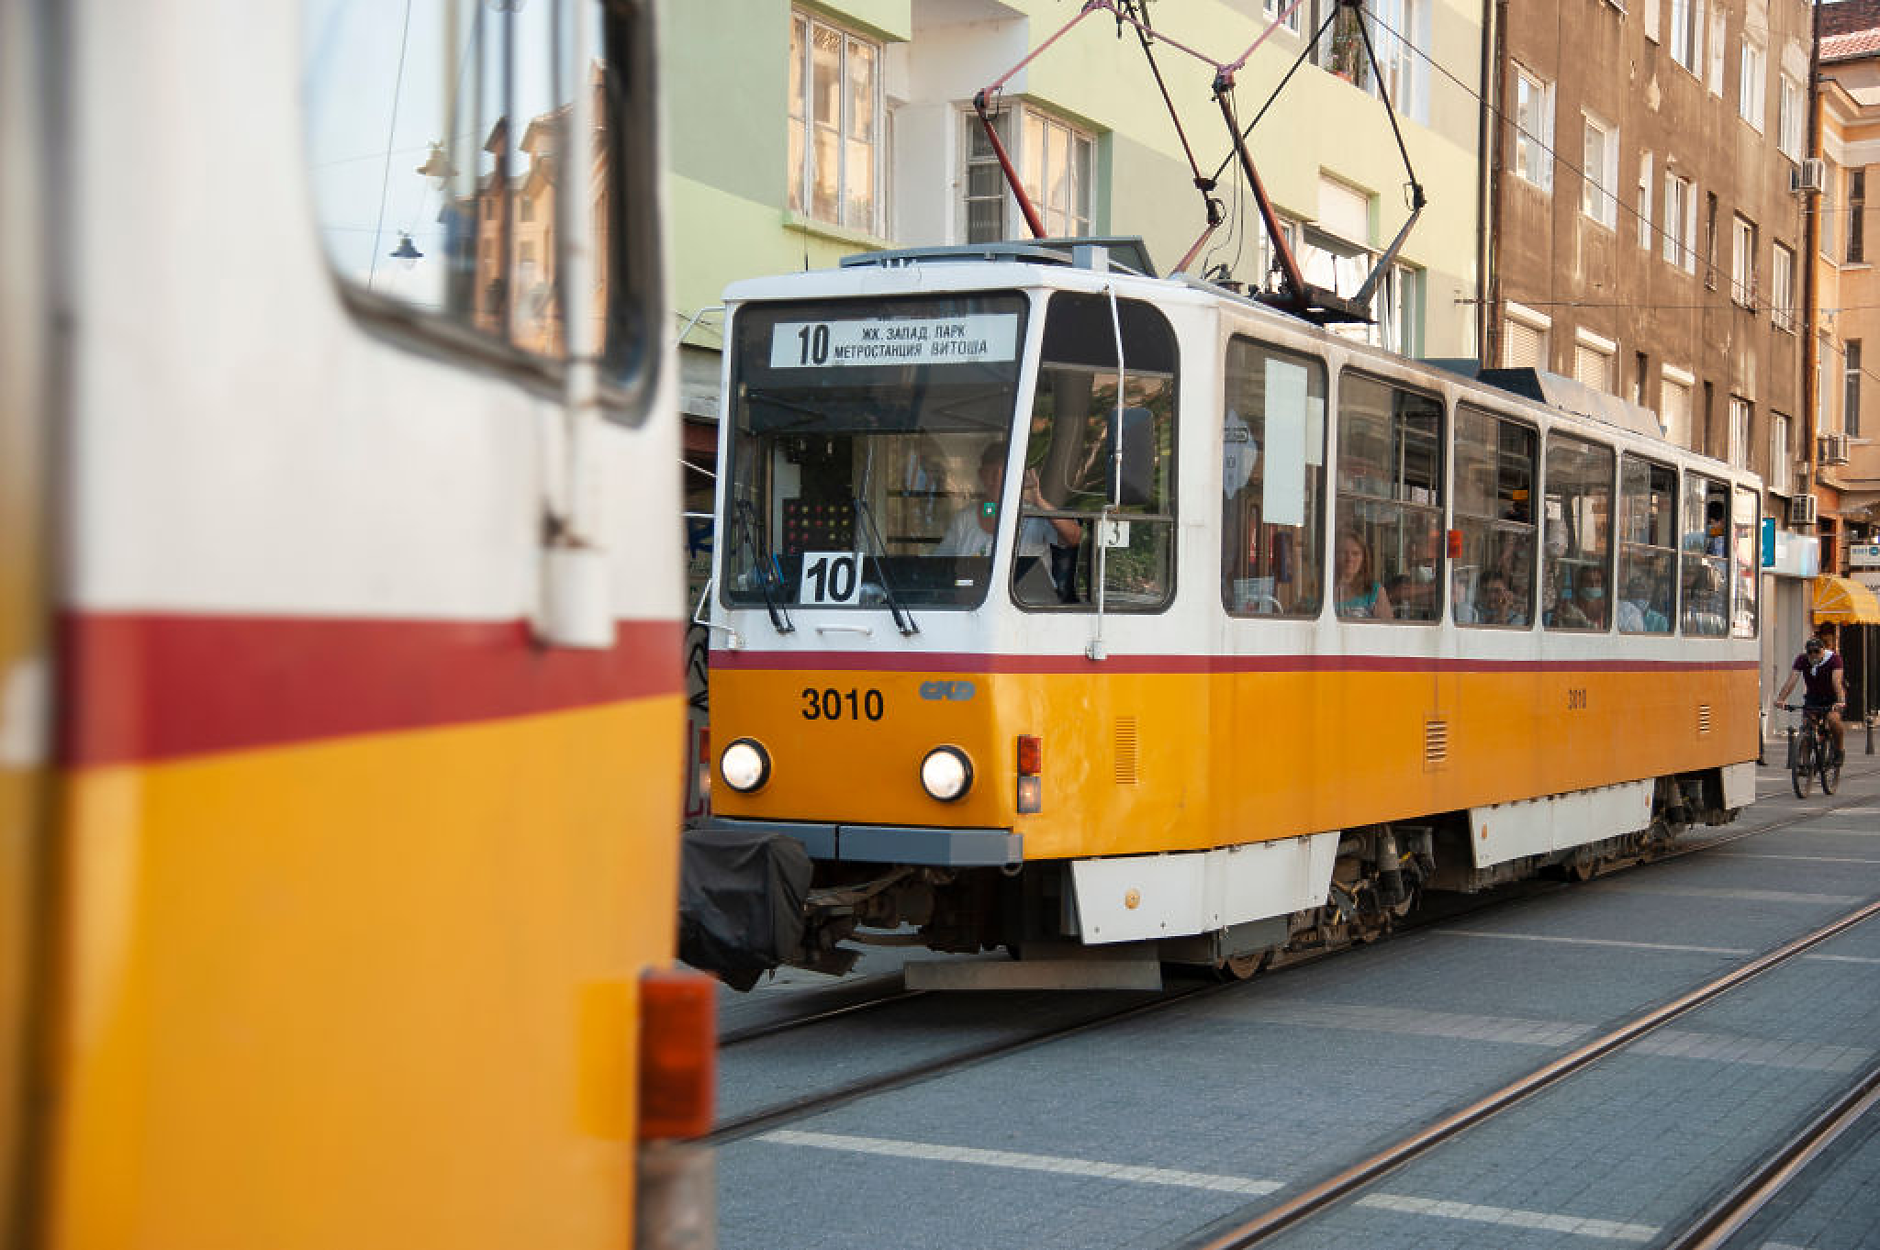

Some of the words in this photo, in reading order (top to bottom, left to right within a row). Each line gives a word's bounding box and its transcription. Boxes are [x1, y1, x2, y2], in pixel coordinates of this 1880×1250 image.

[798, 324, 830, 366] 10
[834, 342, 922, 359] МЕТРОСТАНЦИЯ
[932, 340, 988, 357] ВИТОША
[886, 326, 928, 341] ЗАПАД
[934, 324, 965, 339] ПАРК
[807, 556, 857, 602] 10
[802, 687, 884, 721] 3010
